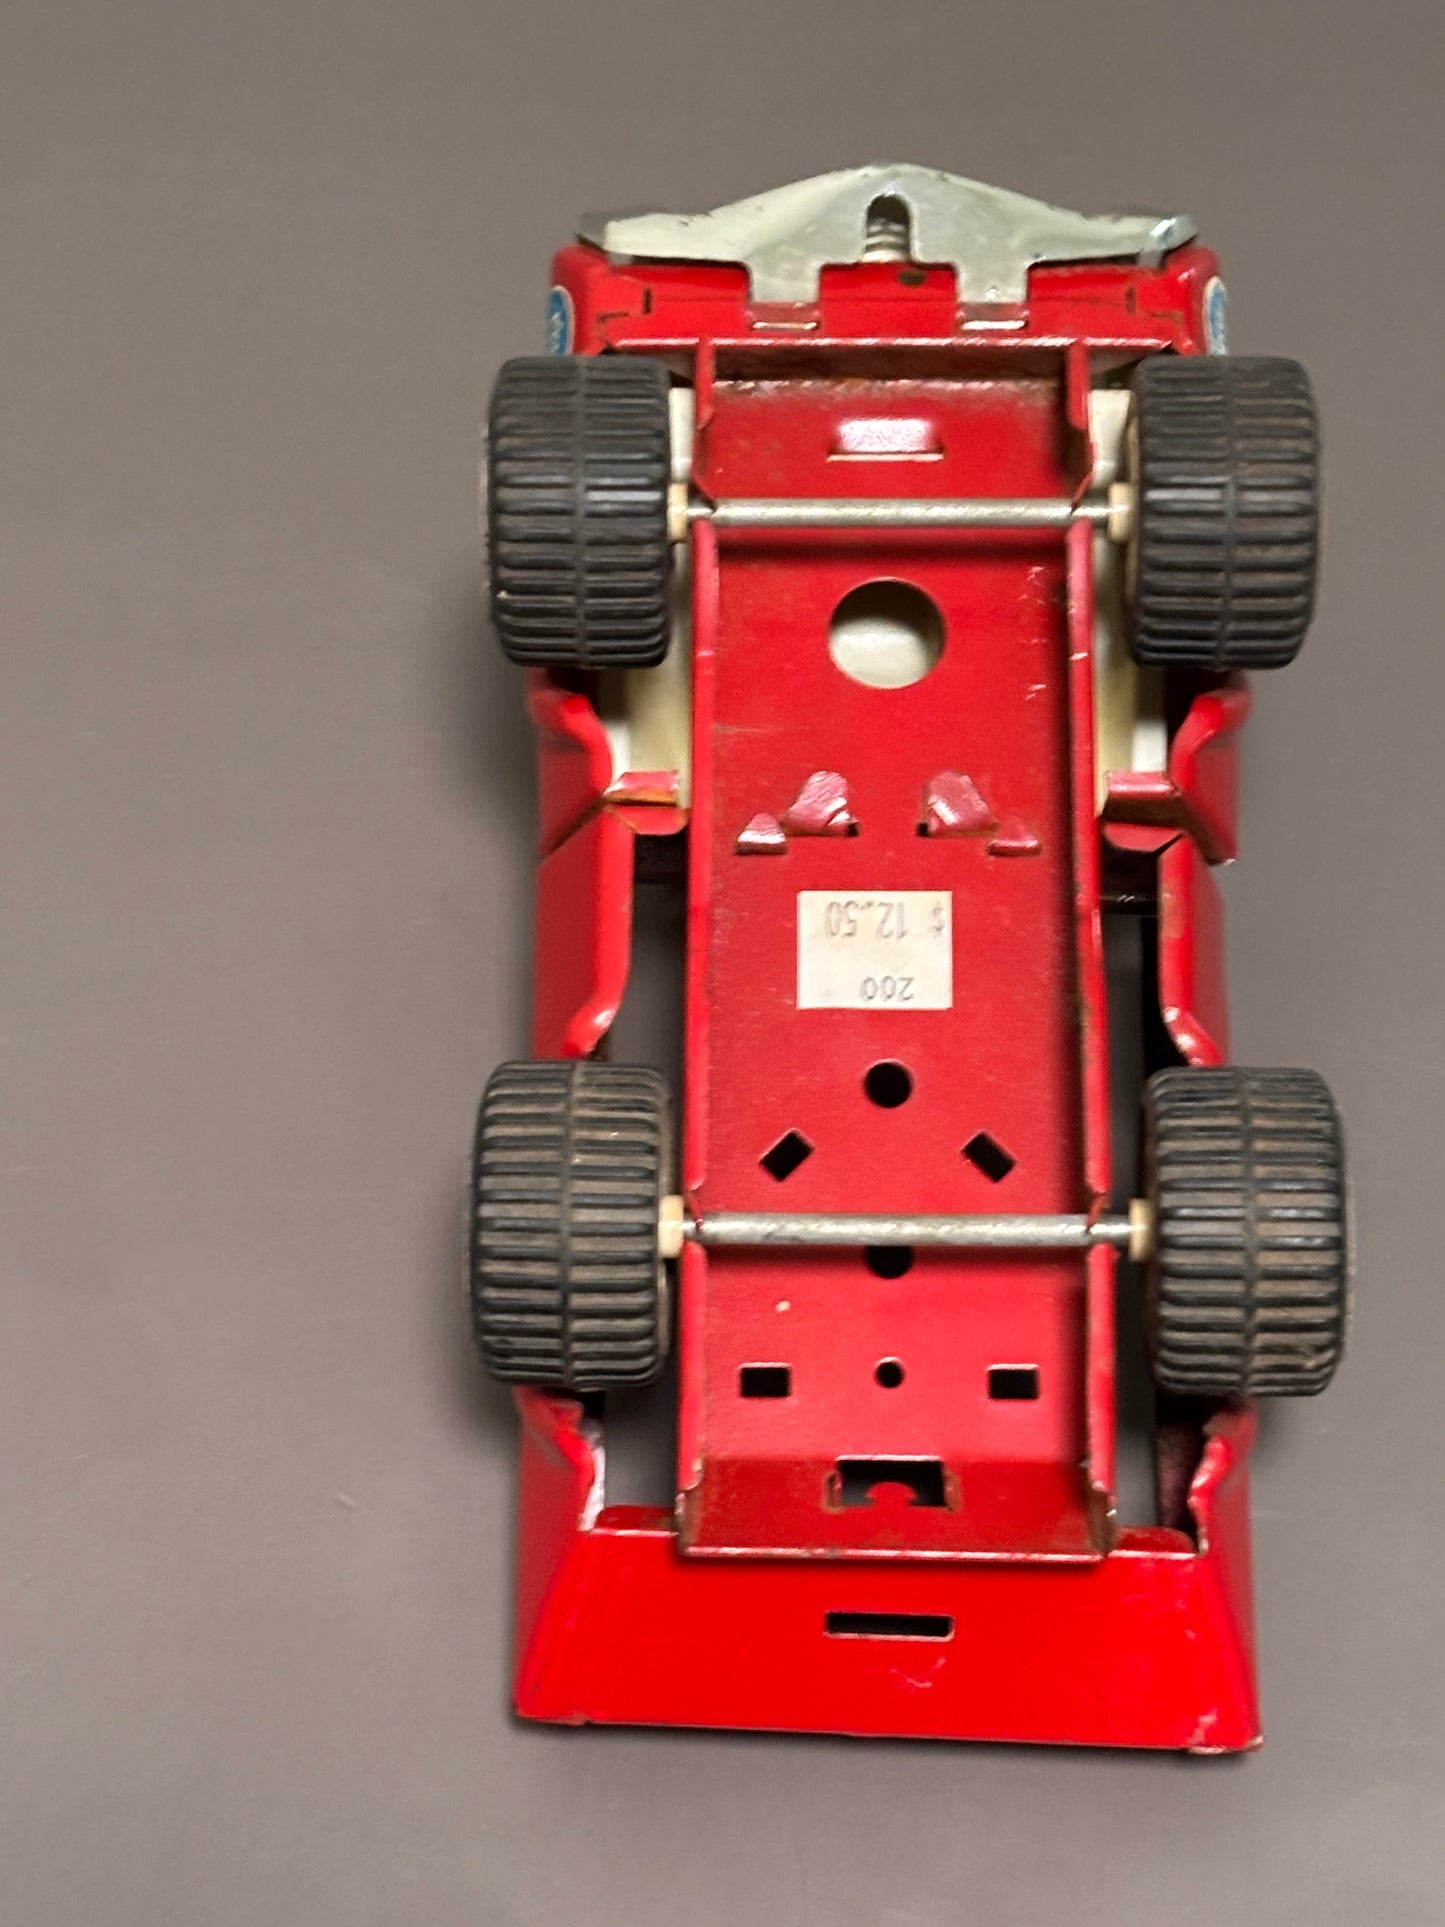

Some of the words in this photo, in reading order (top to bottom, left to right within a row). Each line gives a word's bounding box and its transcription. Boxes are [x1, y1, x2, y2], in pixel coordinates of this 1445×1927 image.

[825, 900, 908, 938] 12.50
[930, 901, 946, 937] $
[860, 975, 915, 1002] 200
